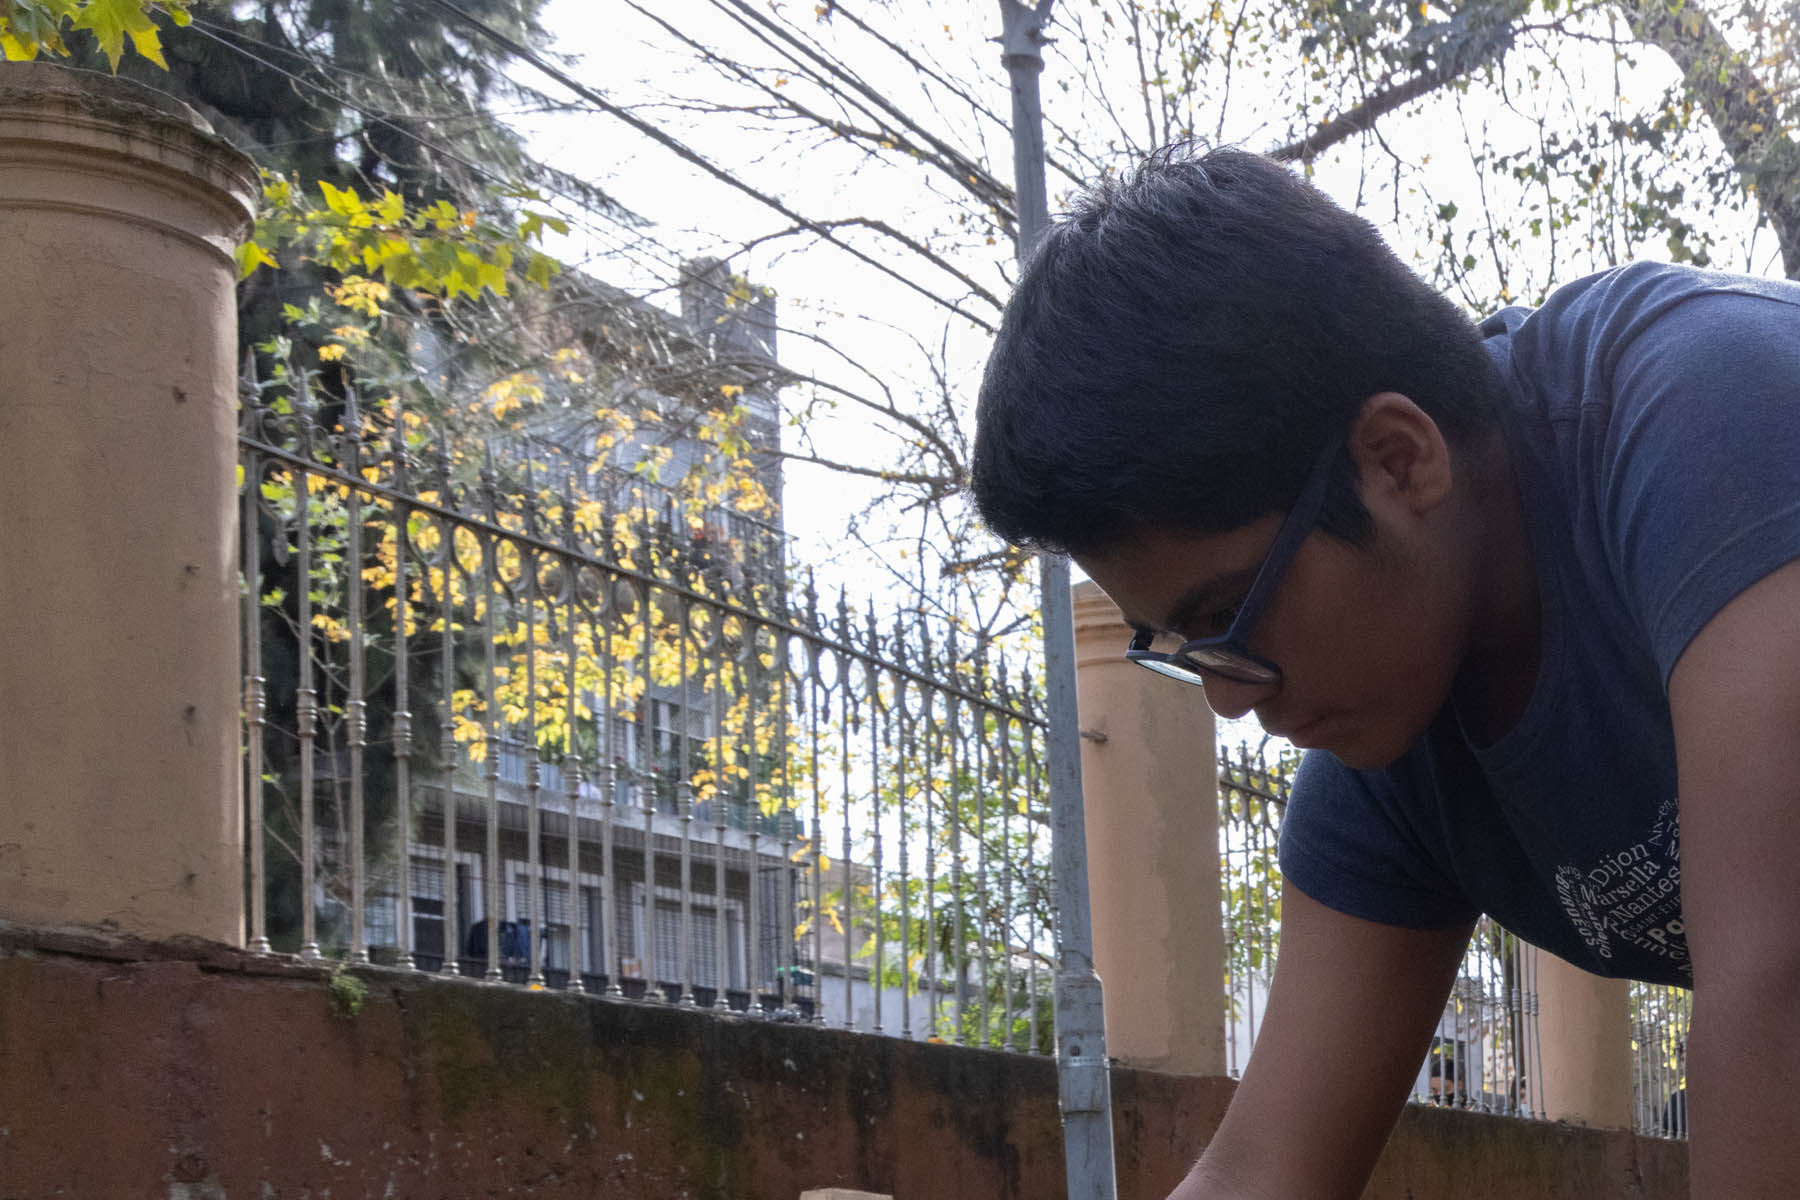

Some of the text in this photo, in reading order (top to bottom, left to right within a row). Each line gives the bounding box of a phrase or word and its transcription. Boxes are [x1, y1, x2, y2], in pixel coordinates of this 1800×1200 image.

[1579, 858, 1661, 907] Marsella
[1588, 841, 1651, 888] Dijon
[1555, 873, 1597, 948] BURDEOS
[1608, 864, 1681, 924] Nantes
